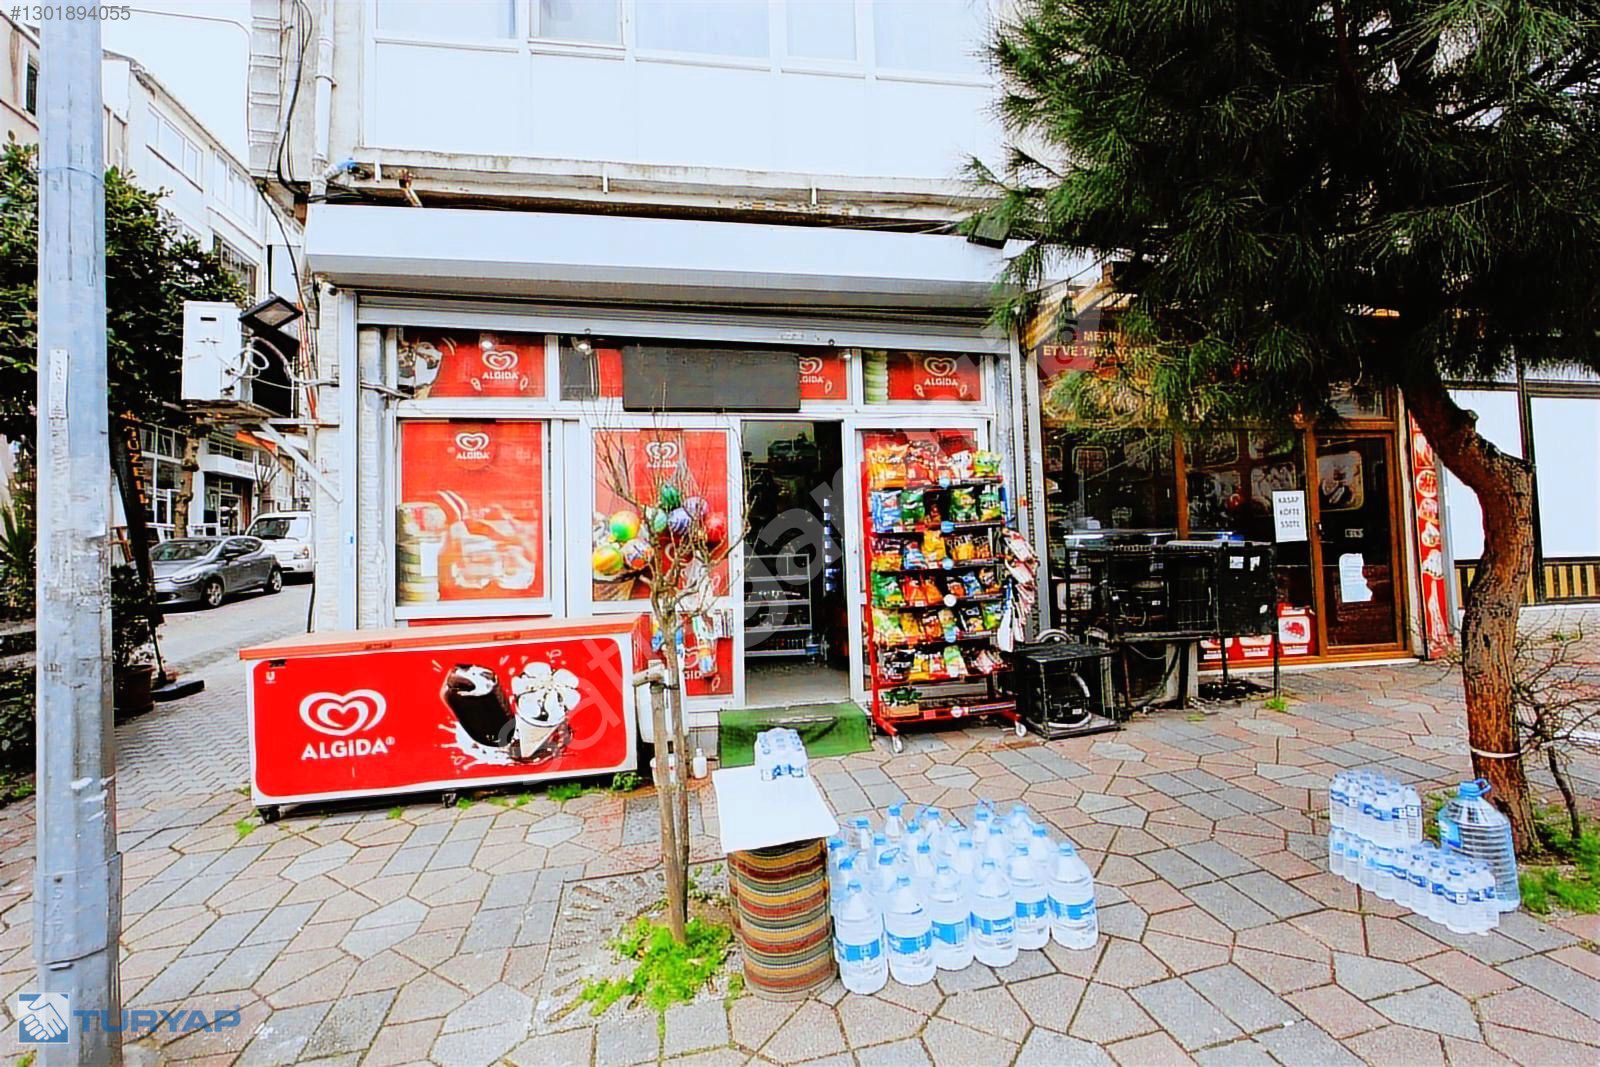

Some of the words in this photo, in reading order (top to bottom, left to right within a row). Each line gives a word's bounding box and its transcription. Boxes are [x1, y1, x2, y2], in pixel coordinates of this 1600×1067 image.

[482, 371, 519, 380] ALGIDA
[924, 377, 959, 386] ALGIDA
[300, 737, 389, 761] ALGIDA
